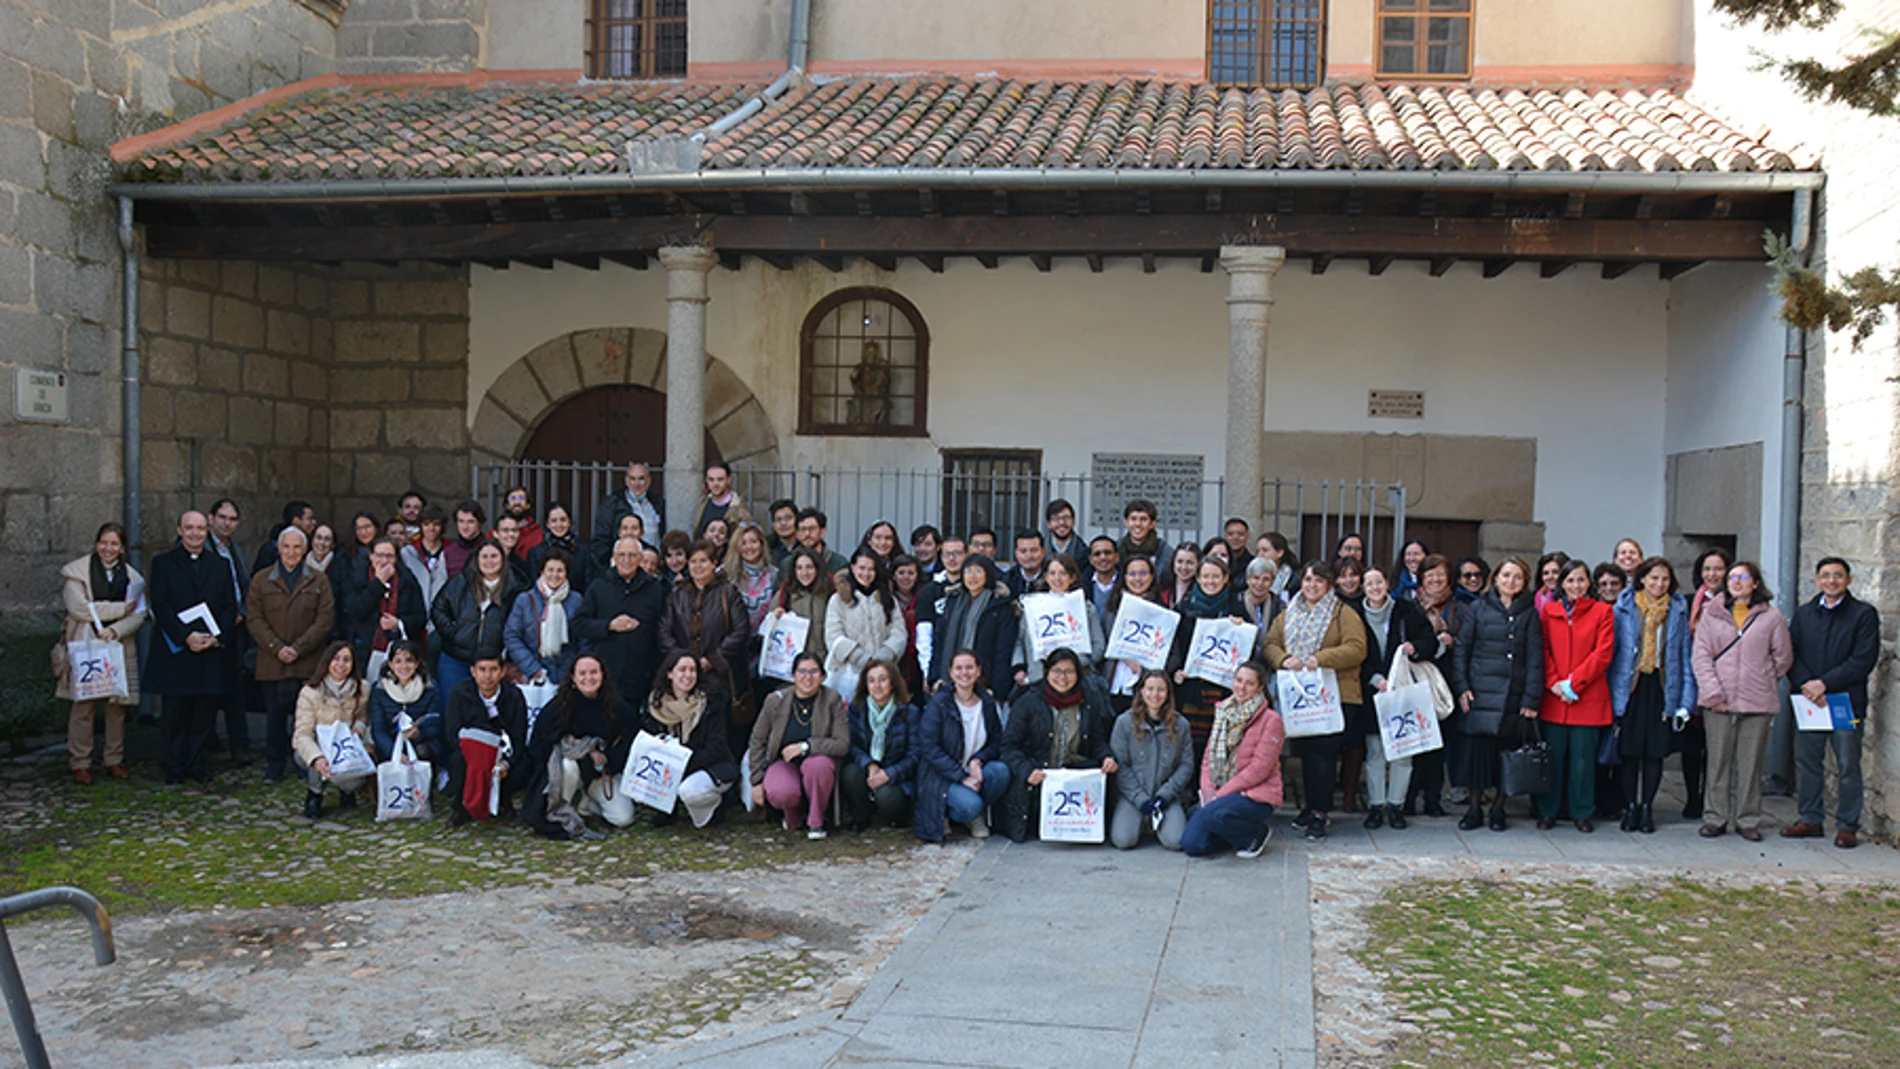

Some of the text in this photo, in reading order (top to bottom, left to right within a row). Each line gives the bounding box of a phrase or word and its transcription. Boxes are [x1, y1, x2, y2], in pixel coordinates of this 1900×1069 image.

[1039, 612, 1066, 639] 25
[1124, 620, 1154, 648] 25
[1201, 635, 1230, 660] 25
[80, 659, 102, 683] 25
[1391, 711, 1415, 739] 25
[332, 737, 354, 765] 25
[636, 755, 664, 781] 25
[388, 786, 414, 809] 25
[1053, 791, 1081, 816] 25
